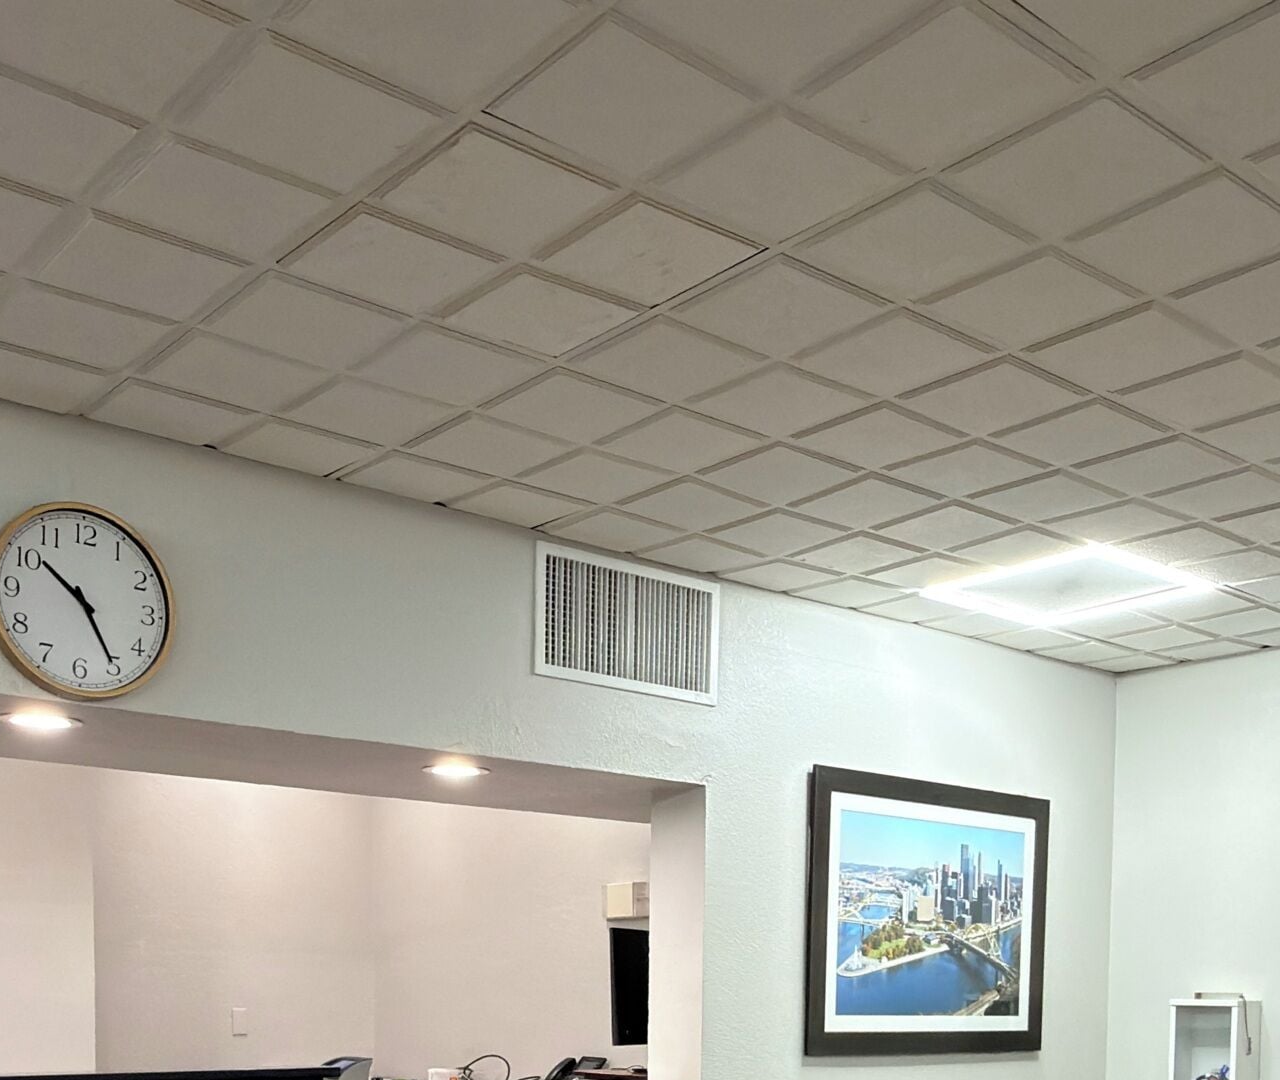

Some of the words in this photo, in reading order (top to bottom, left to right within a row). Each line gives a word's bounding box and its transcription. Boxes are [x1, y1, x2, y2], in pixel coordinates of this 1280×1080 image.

[41, 524, 59, 549] 11
[75, 523, 97, 547] 12
[16, 546, 42, 571] 10
[3, 575, 20, 597] 9
[133, 570, 147, 591] 2
[12, 612, 28, 634] 8
[140, 605, 156, 626] 3
[38, 642, 53, 663] 7
[131, 637, 145, 657] 4
[72, 657, 87, 679] 6
[106, 656, 121, 676] 5
